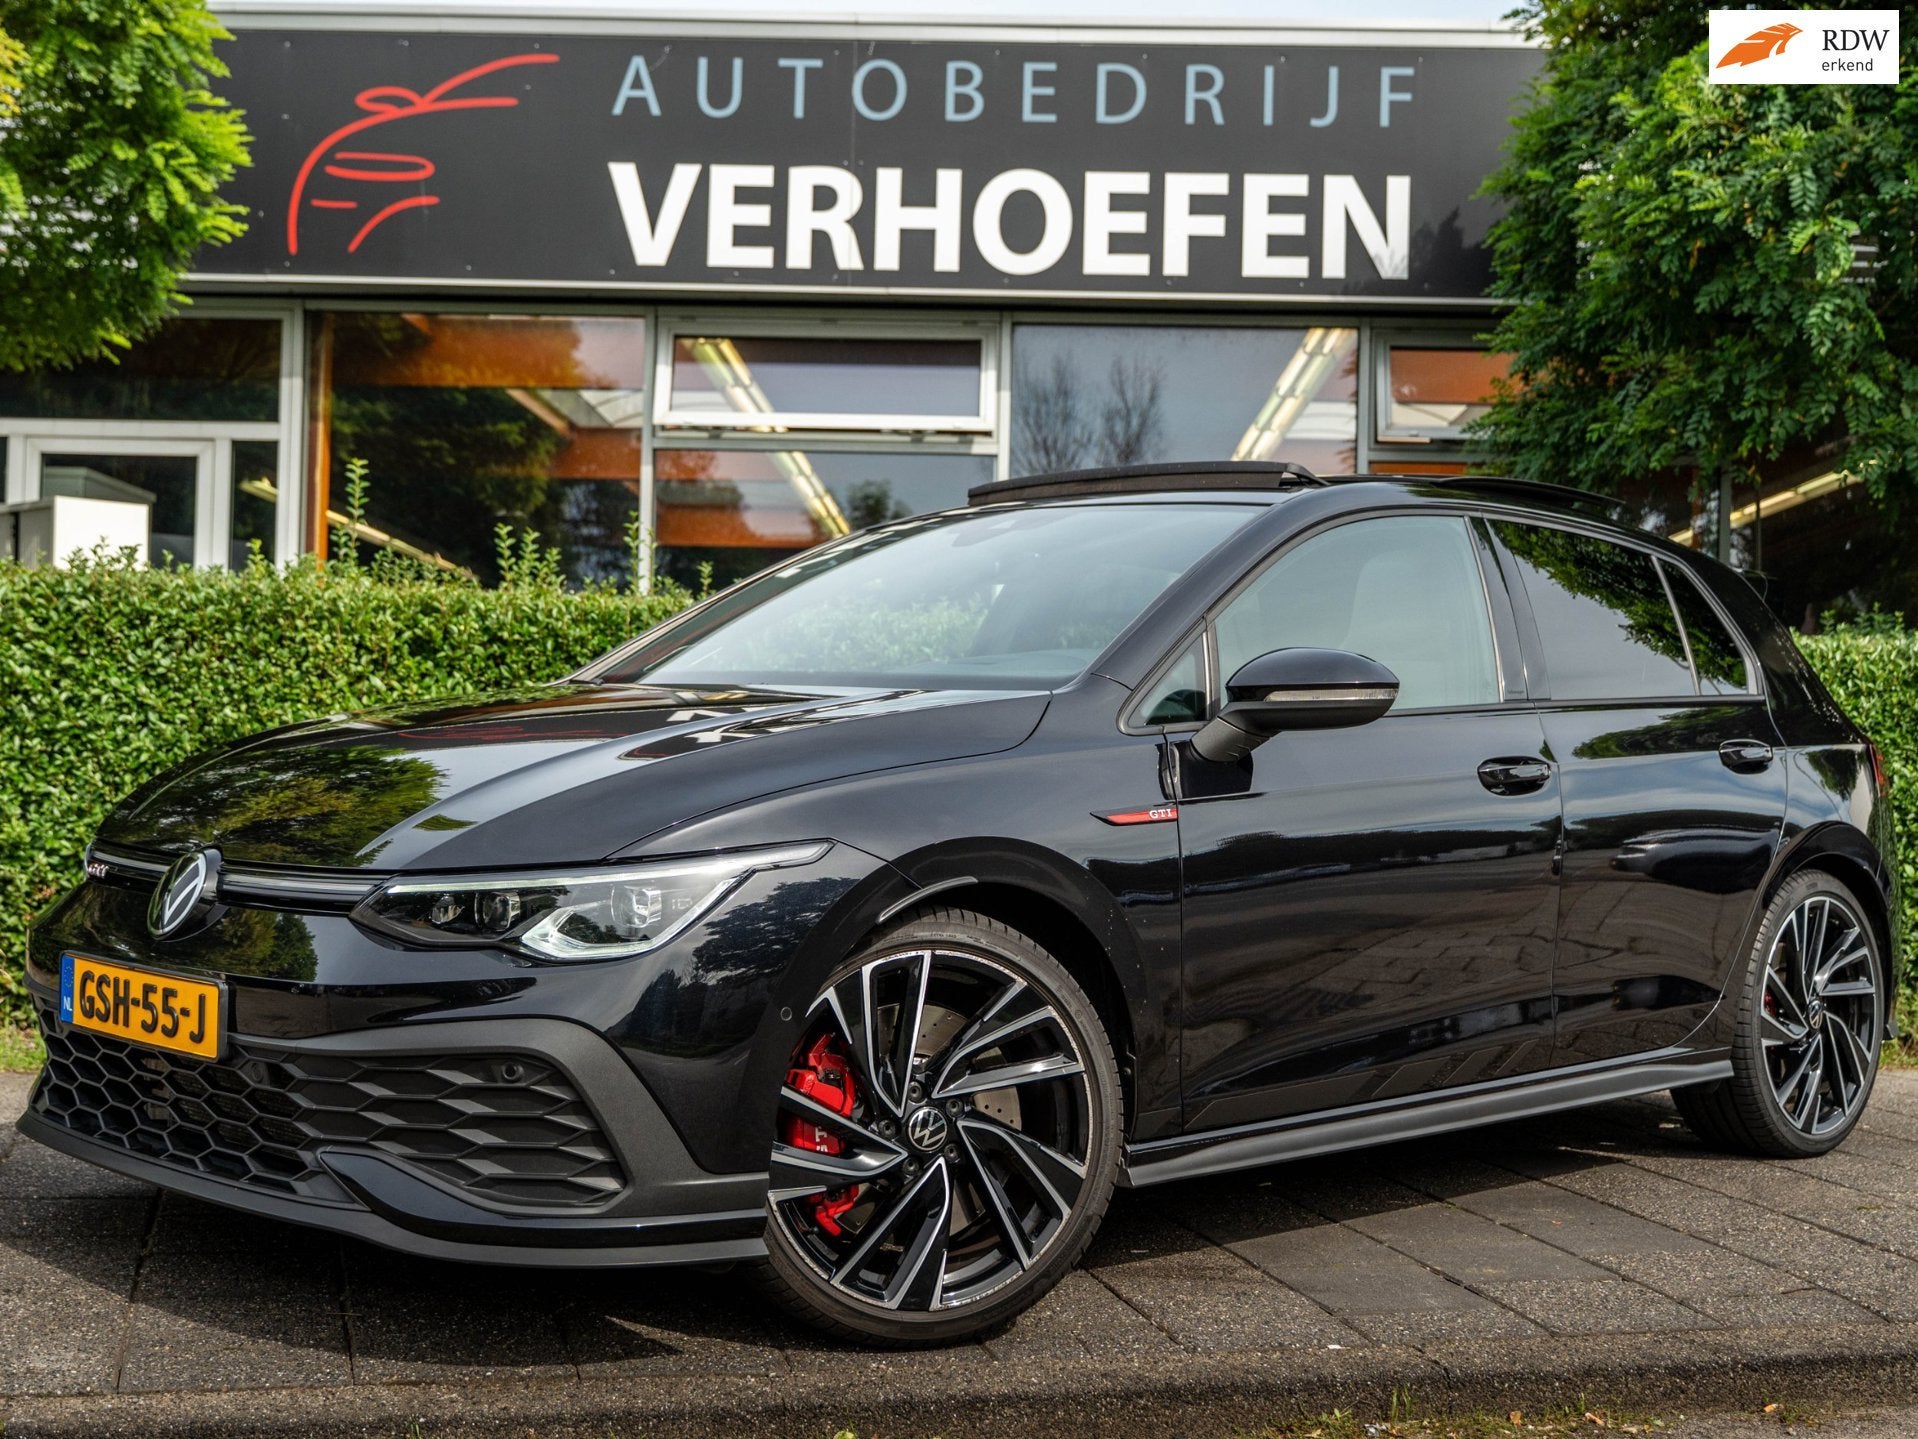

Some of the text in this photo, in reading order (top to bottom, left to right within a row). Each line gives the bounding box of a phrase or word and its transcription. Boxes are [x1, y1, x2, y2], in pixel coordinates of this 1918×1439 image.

[612, 55, 1415, 128] AUTOBEDRIJF
[607, 162, 1412, 280] VERHOEFEN
[1148, 808, 1173, 819] GTI
[63, 995, 73, 1012] NL
[79, 970, 206, 1044] GSH-55-J
